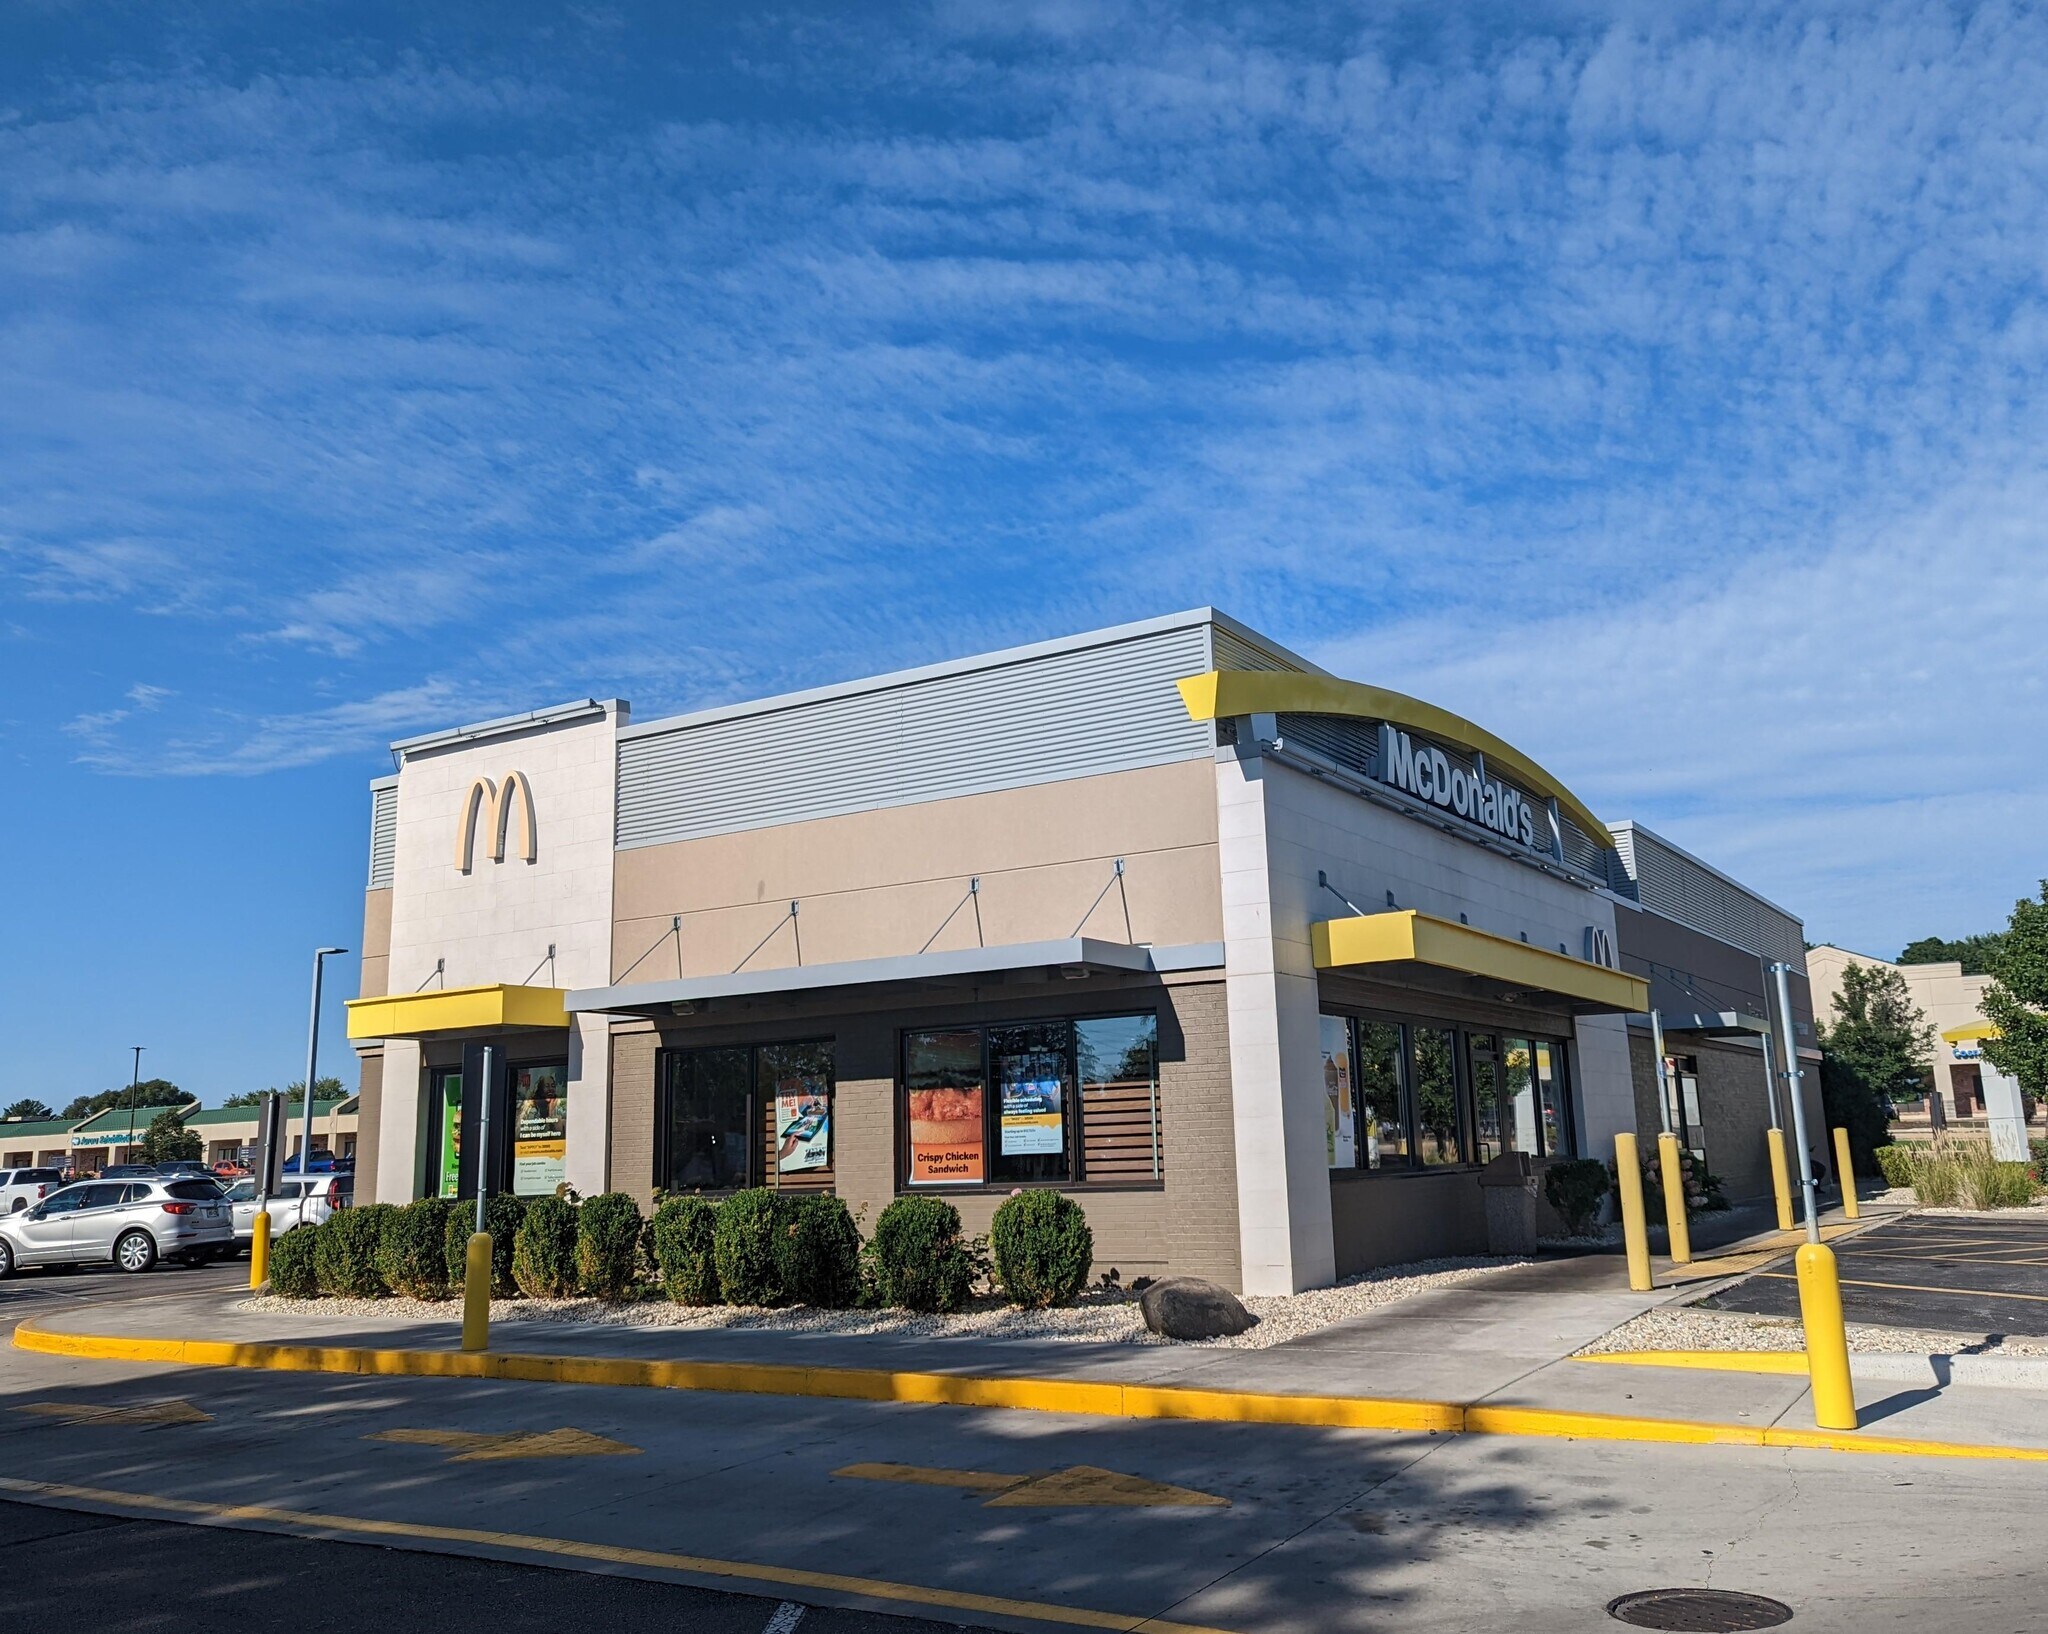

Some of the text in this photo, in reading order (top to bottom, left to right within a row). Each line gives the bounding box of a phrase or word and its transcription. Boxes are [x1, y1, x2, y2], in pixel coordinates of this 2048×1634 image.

[1384, 726, 1534, 846] McDonald's
[781, 1099, 796, 1108] ME!
[918, 1152, 979, 1164] Crispy Chicken
[928, 1164, 968, 1174] Sandwich
